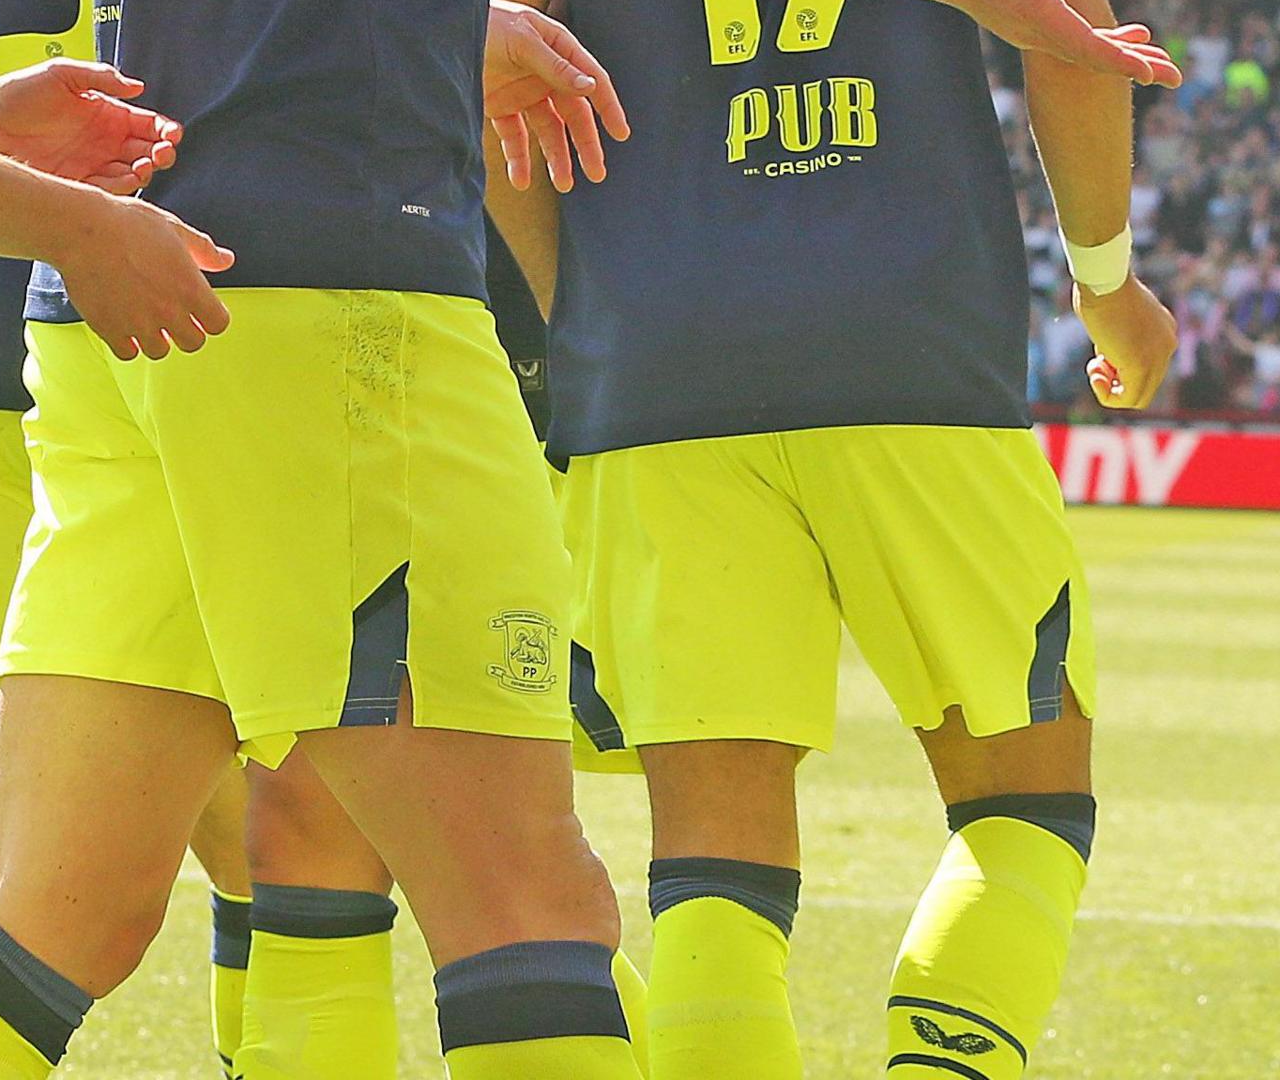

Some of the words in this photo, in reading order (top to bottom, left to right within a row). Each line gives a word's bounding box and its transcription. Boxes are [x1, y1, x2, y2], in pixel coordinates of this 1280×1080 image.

[799, 32, 819, 42] EFL
[728, 45, 747, 55] EFL
[725, 77, 878, 164] PUB
[765, 152, 842, 177] CASINO
[523, 666, 537, 678] PP
